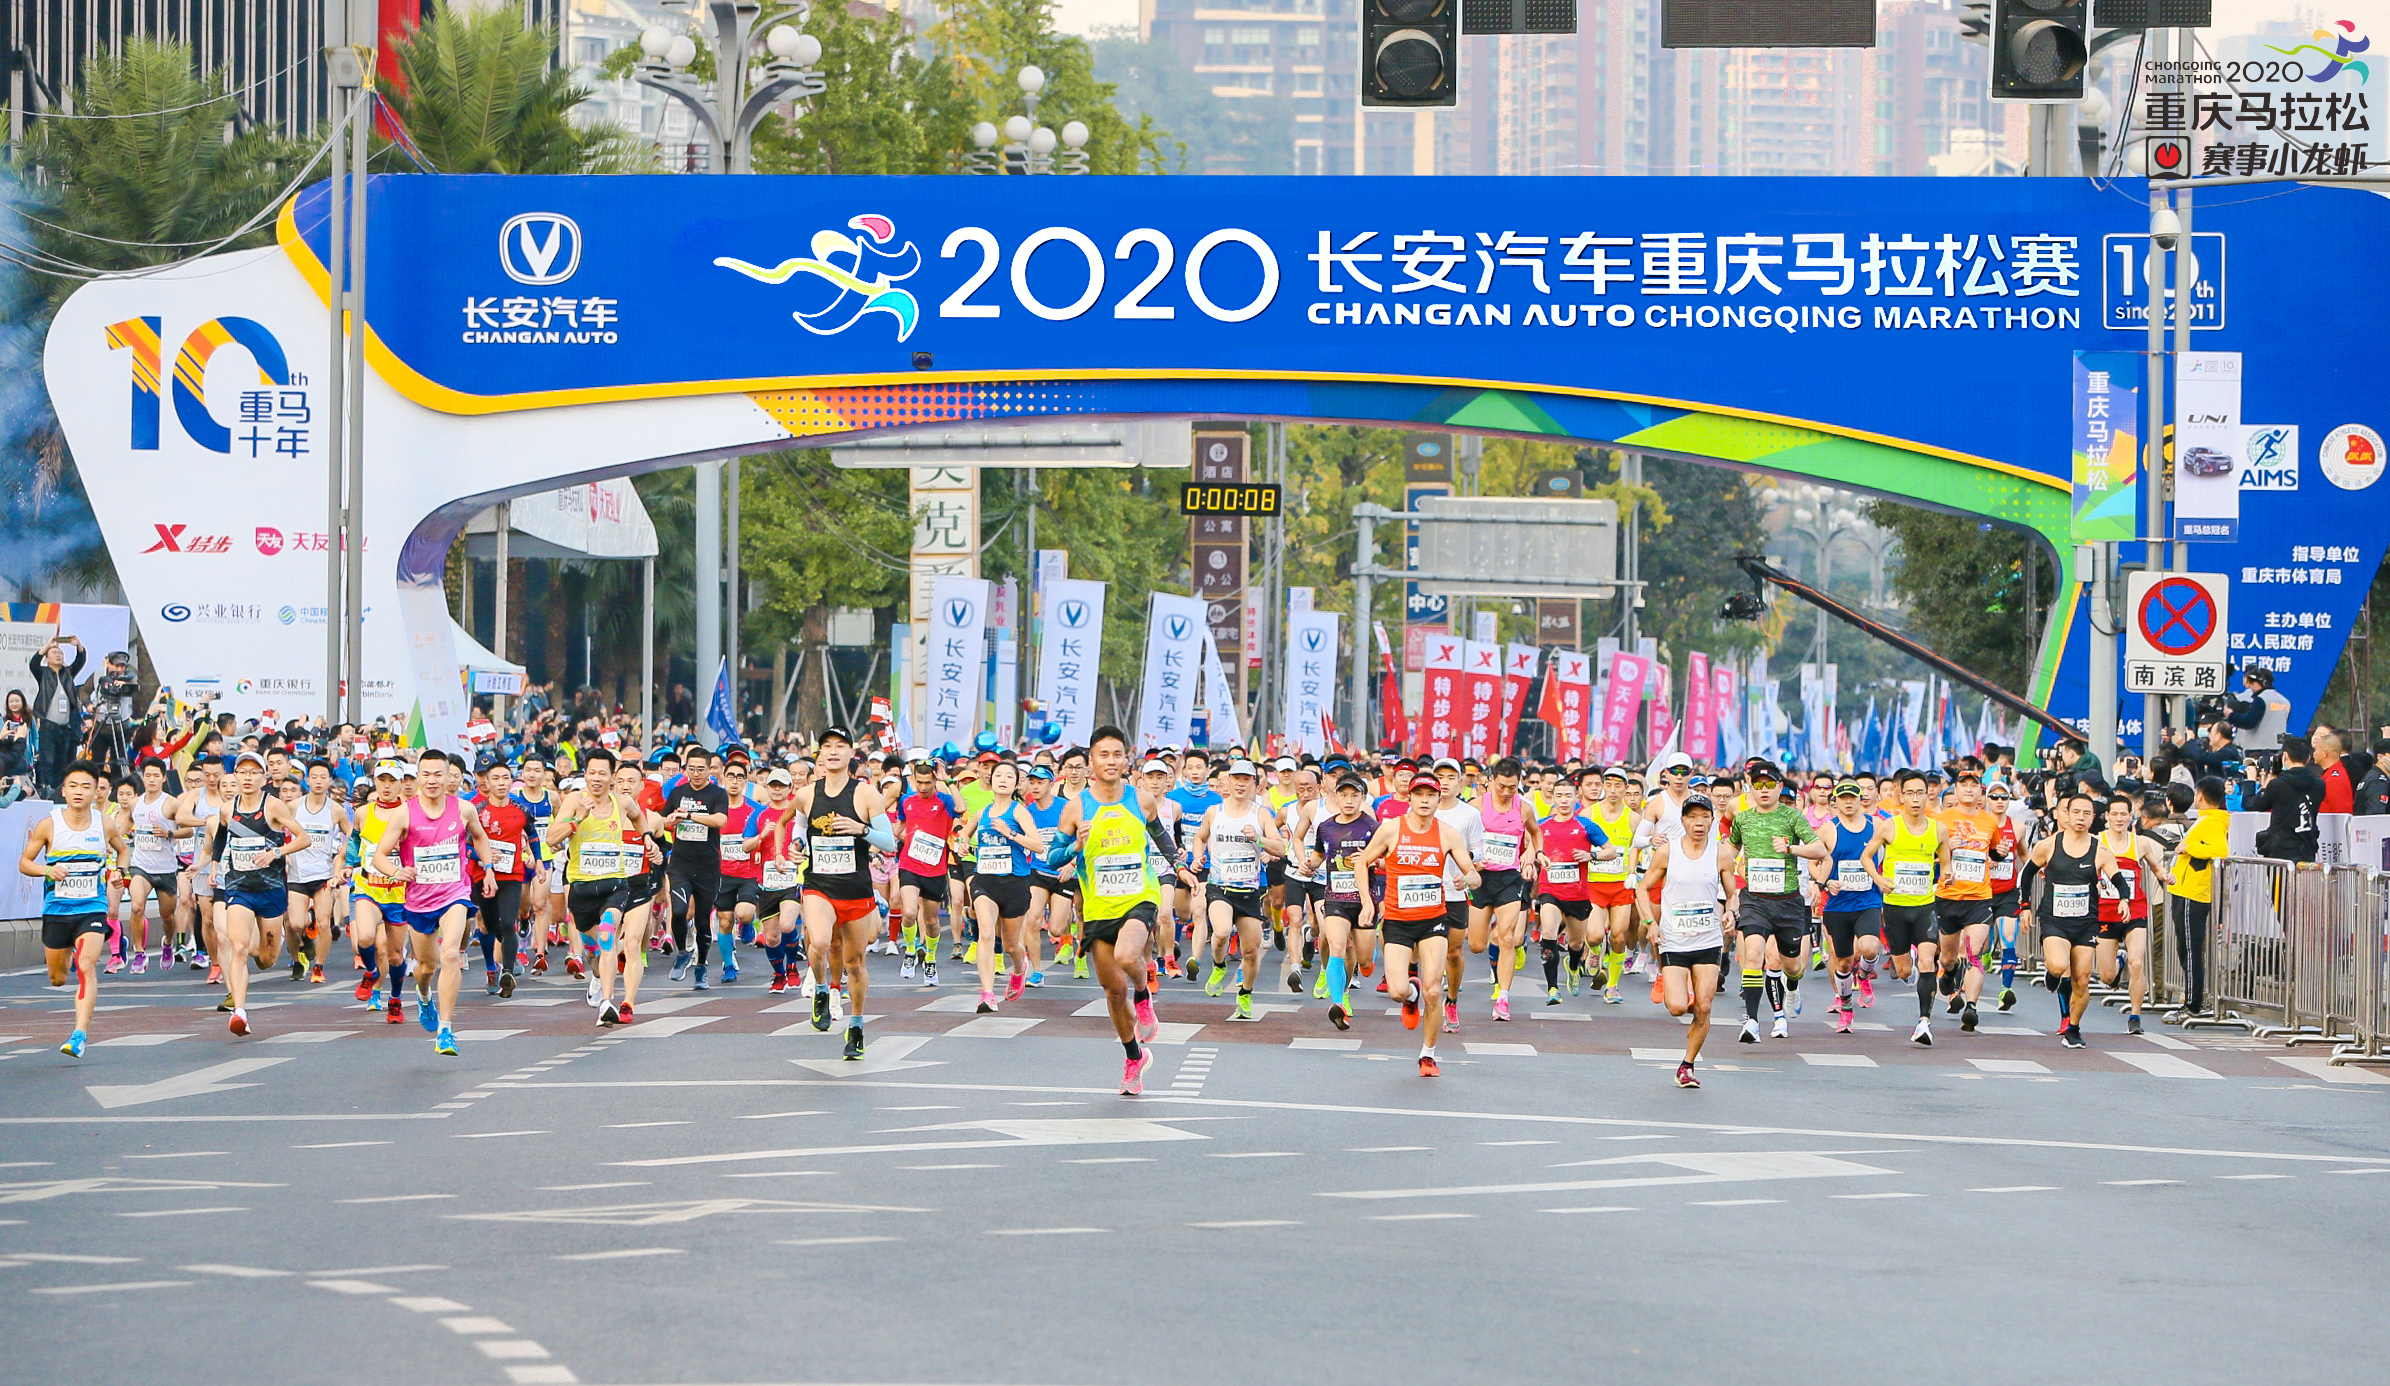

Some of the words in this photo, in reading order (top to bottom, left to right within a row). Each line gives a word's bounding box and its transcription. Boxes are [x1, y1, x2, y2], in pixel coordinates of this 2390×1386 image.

[1307, 230, 2080, 297] 长安汽车重庆马拉松赛
[938, 226, 1280, 322] 2020
[462, 296, 618, 329] 长安汽车
[1307, 302, 1512, 326] CHANGAN
[1522, 304, 1635, 327] AUTO
[1645, 305, 1862, 334] CHONGQING
[1874, 306, 2080, 330] MARATHON
[462, 331, 561, 344] CHANGAN
[563, 331, 618, 344] AUTO
[239, 390, 311, 424] 重马
[2187, 414, 2229, 424] UNI
[2085, 371, 2111, 492] 重庆马拉松
[238, 424, 310, 459] 十年
[2239, 469, 2297, 487] AIMS
[1186, 488, 1275, 511] 0:00:08
[1204, 519, 1233, 533] 公寓
[2183, 524, 2230, 536] 重马总冠名
[2292, 545, 2360, 563] 指导单位
[1203, 573, 1233, 587] 办公
[2241, 567, 2342, 585] 重庆市体育局
[1408, 593, 1445, 612] 中心
[196, 603, 262, 620] 兴业银行
[300, 607, 331, 617] 中国移
[2264, 611, 2331, 629] 主办单位
[1053, 638, 1083, 728] 长安汽车
[2133, 664, 2217, 689] 南滨路
[259, 679, 312, 690] 重庆银行
[934, 638, 966, 731] 长安汽车
[1156, 650, 1185, 733] 长安汽车
[1299, 660, 1321, 737] 长安汽车
[723, 847, 744, 855] A030
[913, 843, 939, 859] A0478
[1397, 845, 1440, 853] GUANGZHOU
[1485, 847, 1513, 857] A0608
[585, 858, 616, 868] A0058
[817, 853, 851, 864] A0373
[1150, 857, 1164, 866] 067
[1397, 855, 1421, 865] 2019
[420, 862, 456, 873] A0047
[981, 861, 1007, 870] A6011
[1226, 864, 1252, 873] A0131
[1955, 862, 1981, 873] B3341
[766, 874, 794, 882] A0539
[1101, 872, 1139, 885] A0272
[1550, 871, 1577, 879] A0033
[1751, 873, 1781, 884] A0416
[1842, 874, 1870, 883] A0081
[1898, 876, 1927, 886] A0010
[60, 878, 93, 888] A0001
[1403, 891, 1437, 902] A0196
[2056, 899, 2086, 908] A0390
[1677, 917, 1711, 928] A0545
